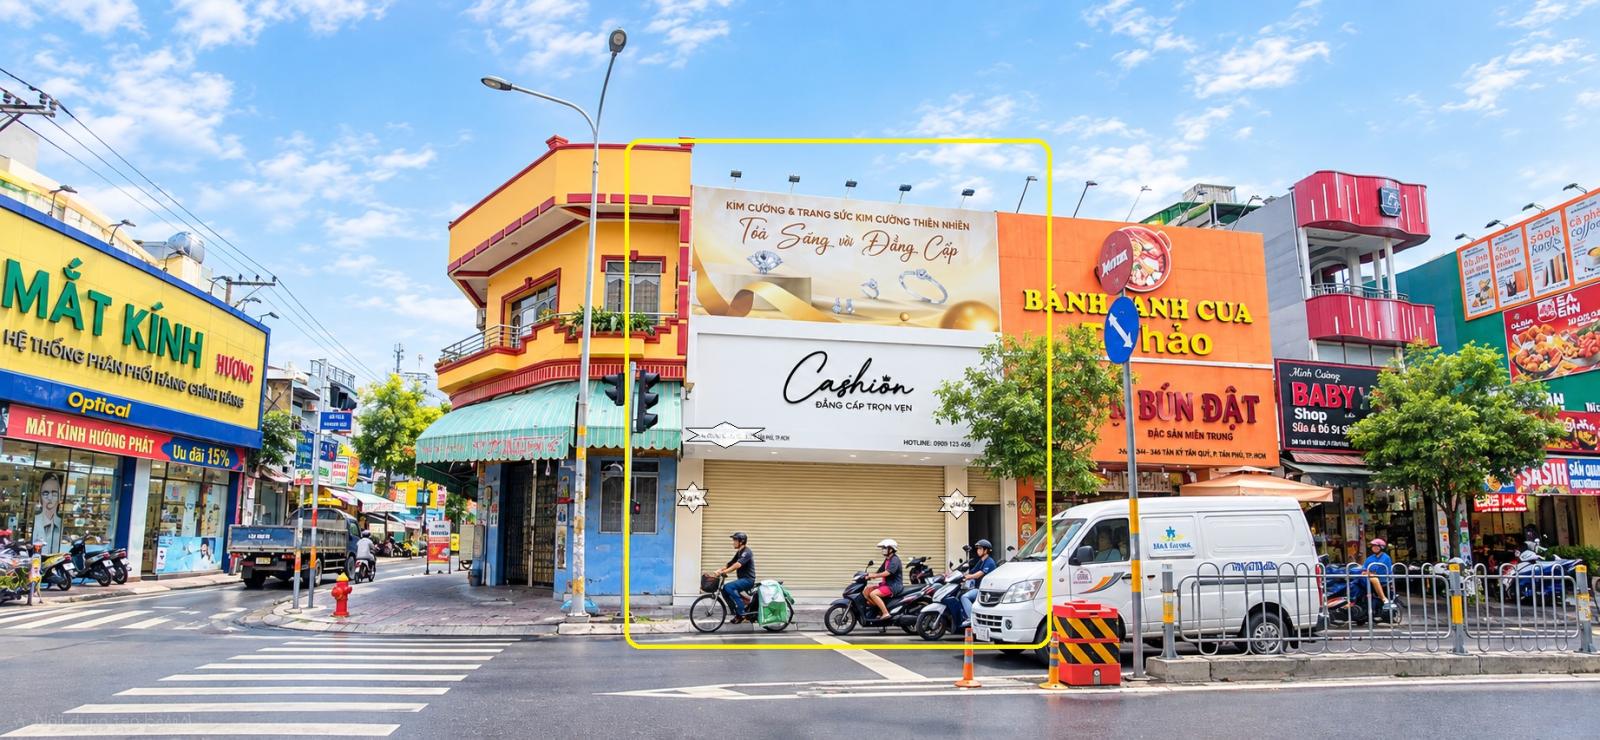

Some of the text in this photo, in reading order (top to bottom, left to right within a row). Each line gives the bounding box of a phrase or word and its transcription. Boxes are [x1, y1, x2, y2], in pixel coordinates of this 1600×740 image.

[797, 208, 831, 218] TRANG
[833, 209, 853, 220] SỨC
[856, 213, 873, 222] KIM
[875, 214, 911, 226] CƯỜNG
[913, 217, 940, 228] THIÊN
[2, 257, 204, 369] MẮT KÍNH
[1023, 284, 1254, 324] BÁNH ANH CUA
[4, 329, 28, 352] HỆ
[31, 337, 85, 364] THỐNG
[87, 353, 123, 376] PHÂN
[124, 363, 153, 384] PHỐI
[215, 353, 254, 384] HƯƠNG
[783, 351, 914, 405] Cashion
[68, 391, 132, 420] Optical
[867, 402, 892, 413] TRỌN
[894, 404, 913, 414] VẸN
[1138, 382, 1194, 422] BÚN
[1291, 381, 1356, 409] BABY
[1294, 407, 1328, 423] Shop
[128, 435, 155, 454] PHÁT
[903, 439, 932, 447] HOTLINE:
[1206, 432, 1233, 441] TRUNG
[207, 447, 230, 467] 15%
